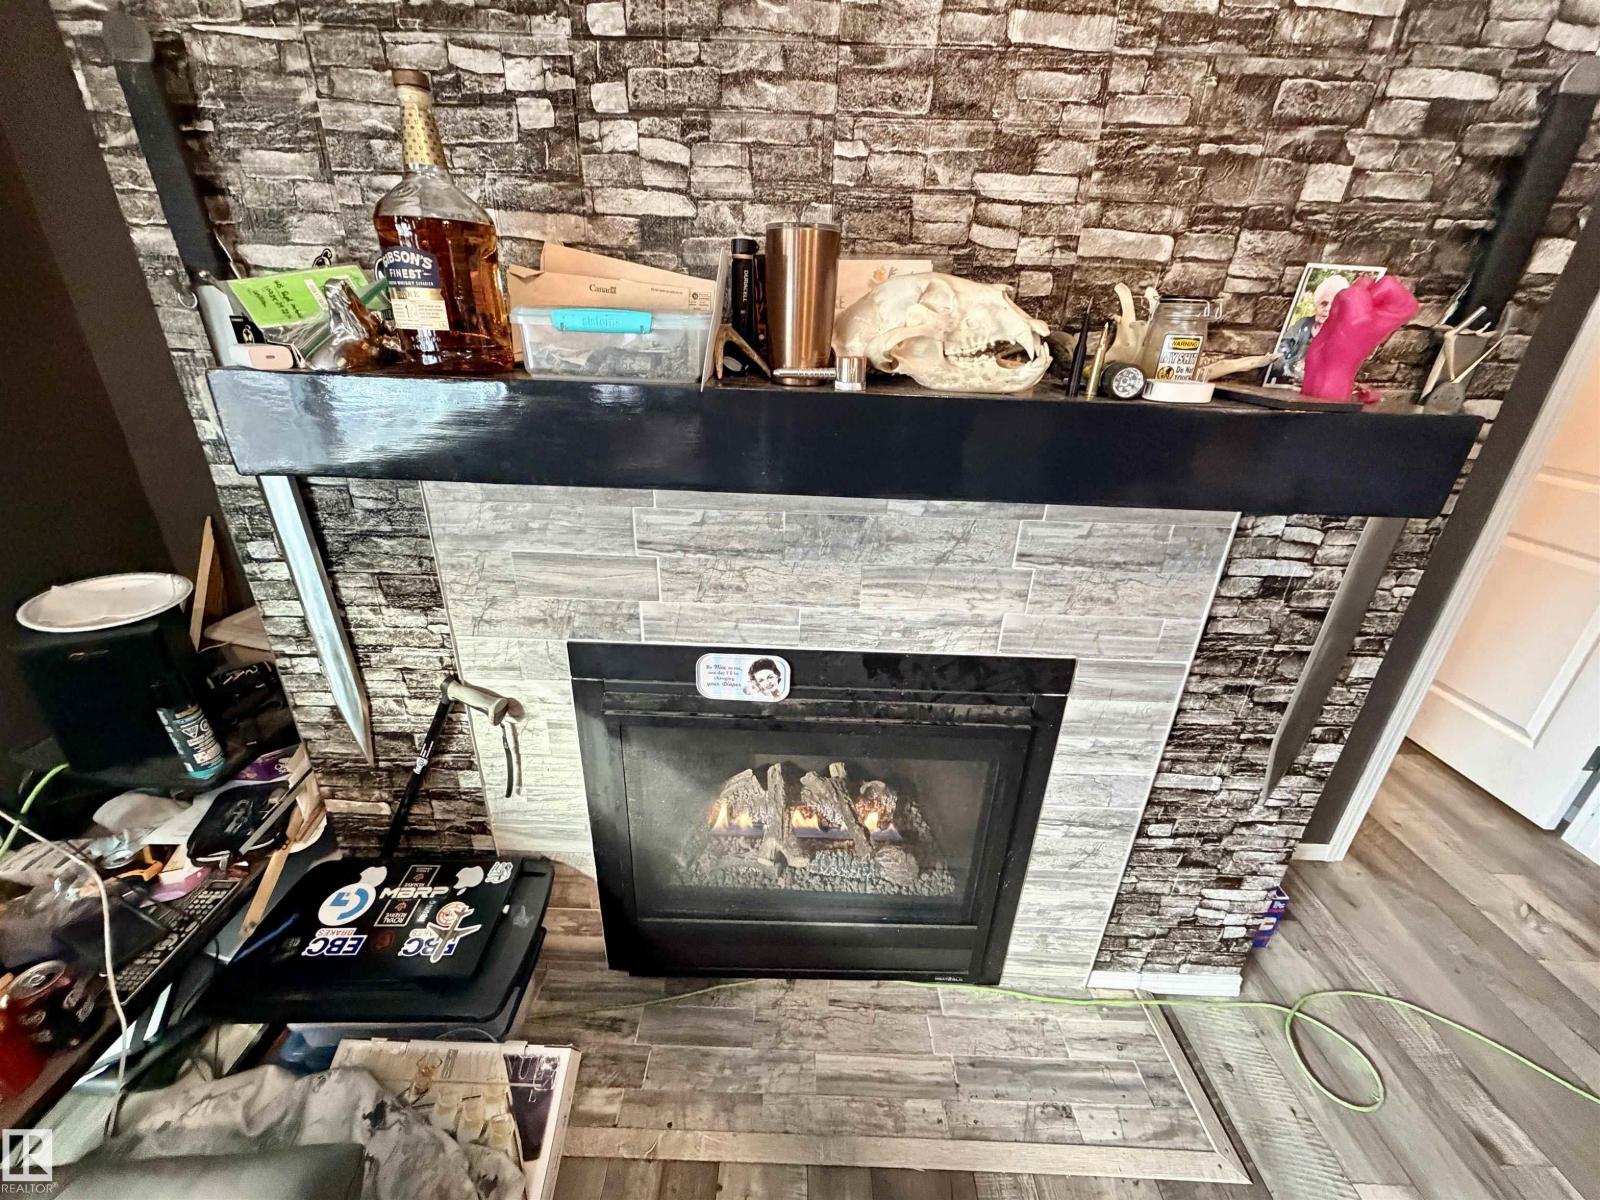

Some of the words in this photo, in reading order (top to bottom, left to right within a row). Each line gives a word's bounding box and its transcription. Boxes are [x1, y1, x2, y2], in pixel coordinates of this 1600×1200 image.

[382, 250, 433, 269] GIBSON'S
[389, 268, 422, 279] FINEST
[1171, 340, 1199, 348] WARNING
[378, 886, 450, 899] MBRP
[317, 929, 355, 937] BRAKES
[306, 936, 365, 955] EBC
